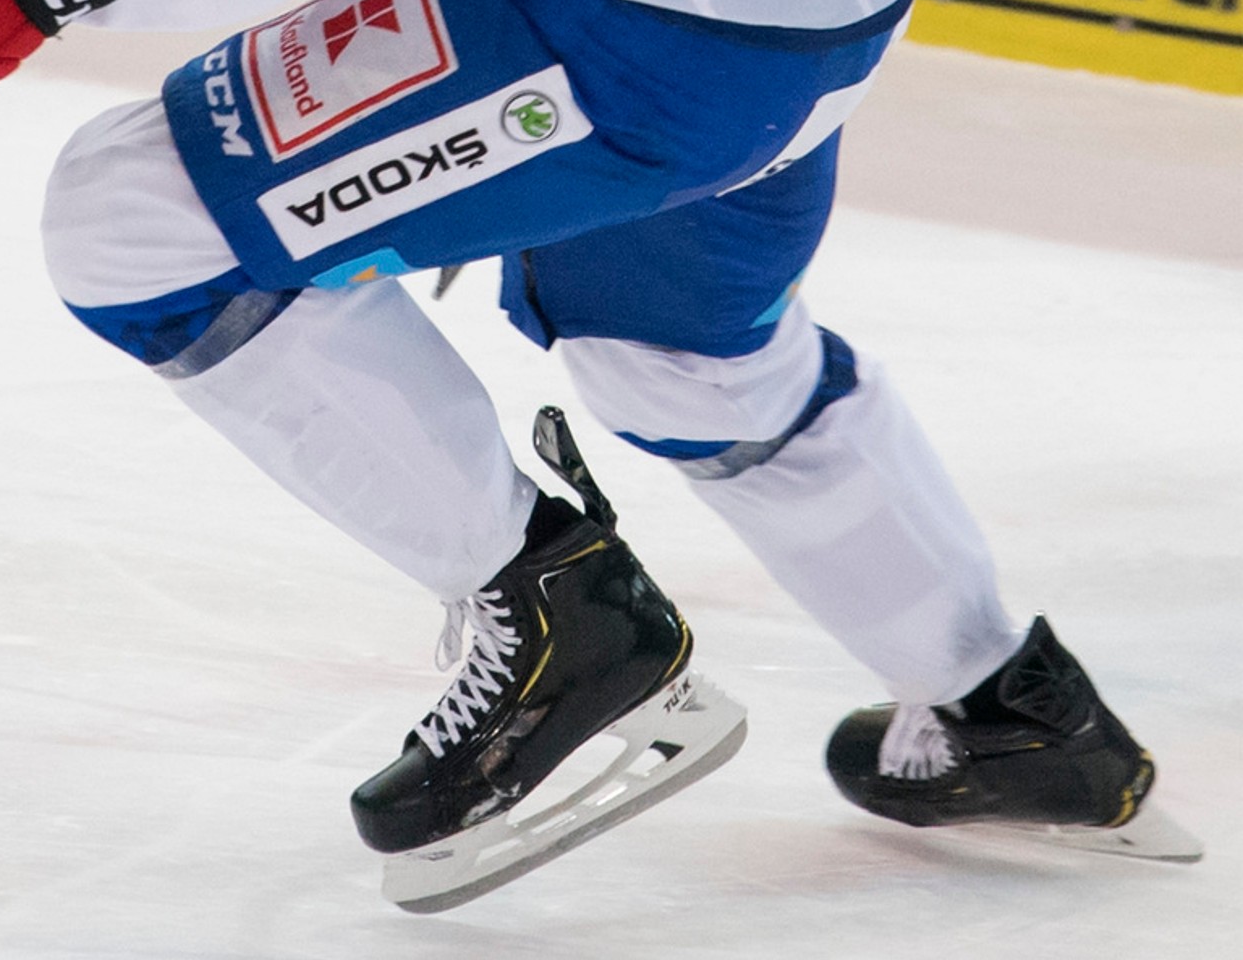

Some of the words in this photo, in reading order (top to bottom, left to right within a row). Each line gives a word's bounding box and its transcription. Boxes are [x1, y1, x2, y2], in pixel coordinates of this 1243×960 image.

[203, 46, 254, 156] CCM
[280, 14, 324, 119] Kaufland
[286, 127, 489, 227] ŠKODA
